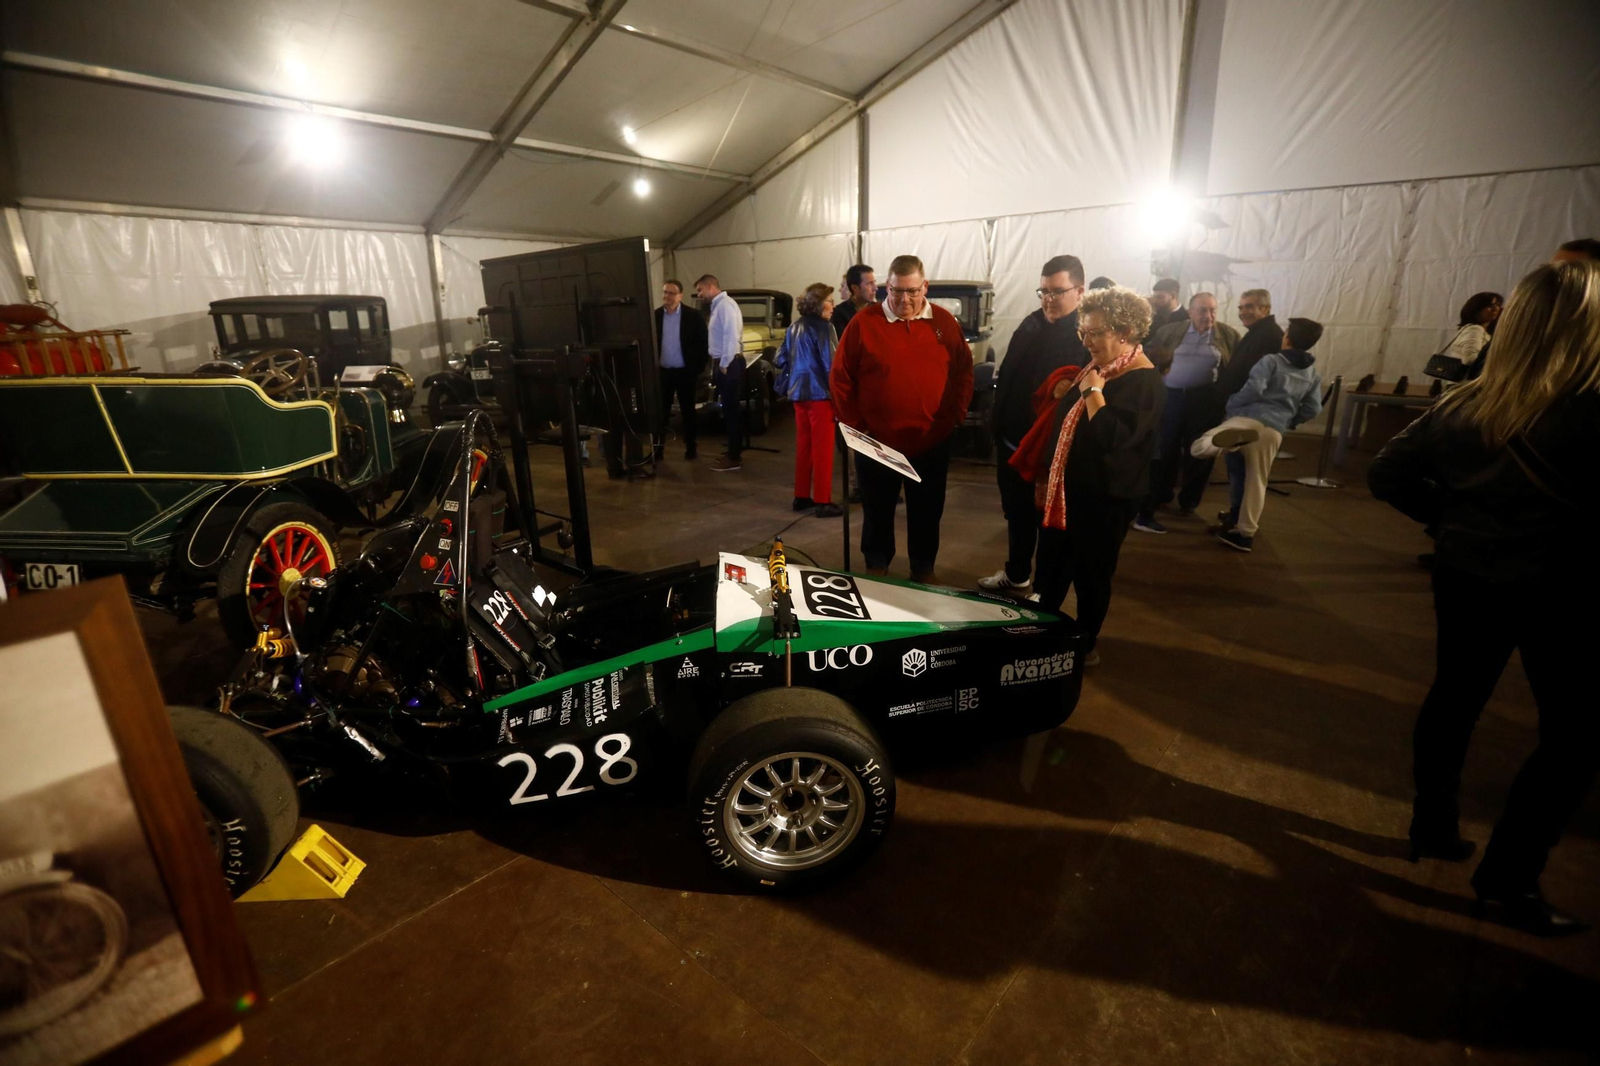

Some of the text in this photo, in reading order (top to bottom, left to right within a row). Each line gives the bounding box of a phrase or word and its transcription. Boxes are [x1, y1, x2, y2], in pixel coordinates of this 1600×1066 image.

[445, 501, 458, 510] OFF
[439, 539, 450, 549] ON
[28, 564, 76, 589] CO-1
[806, 574, 865, 619] 228
[483, 590, 512, 626] 228
[805, 644, 874, 672] UCO
[930, 645, 967, 657] UNIVERSIDAD
[677, 667, 699, 675] AIRE
[729, 662, 763, 674] CRT
[930, 659, 957, 669] CÓRDOBA
[1000, 658, 1074, 682] Avanza
[592, 677, 608, 724] Publikit
[958, 687, 978, 700] EP
[585, 697, 593, 728] PUBLICIDAD
[888, 708, 917, 718] SUPERIOR
[889, 703, 916, 712] ESCUELA
[958, 697, 980, 712] SC
[497, 733, 638, 806] 228
[855, 758, 889, 836] Hoosier
[701, 797, 739, 870] Hoosier
